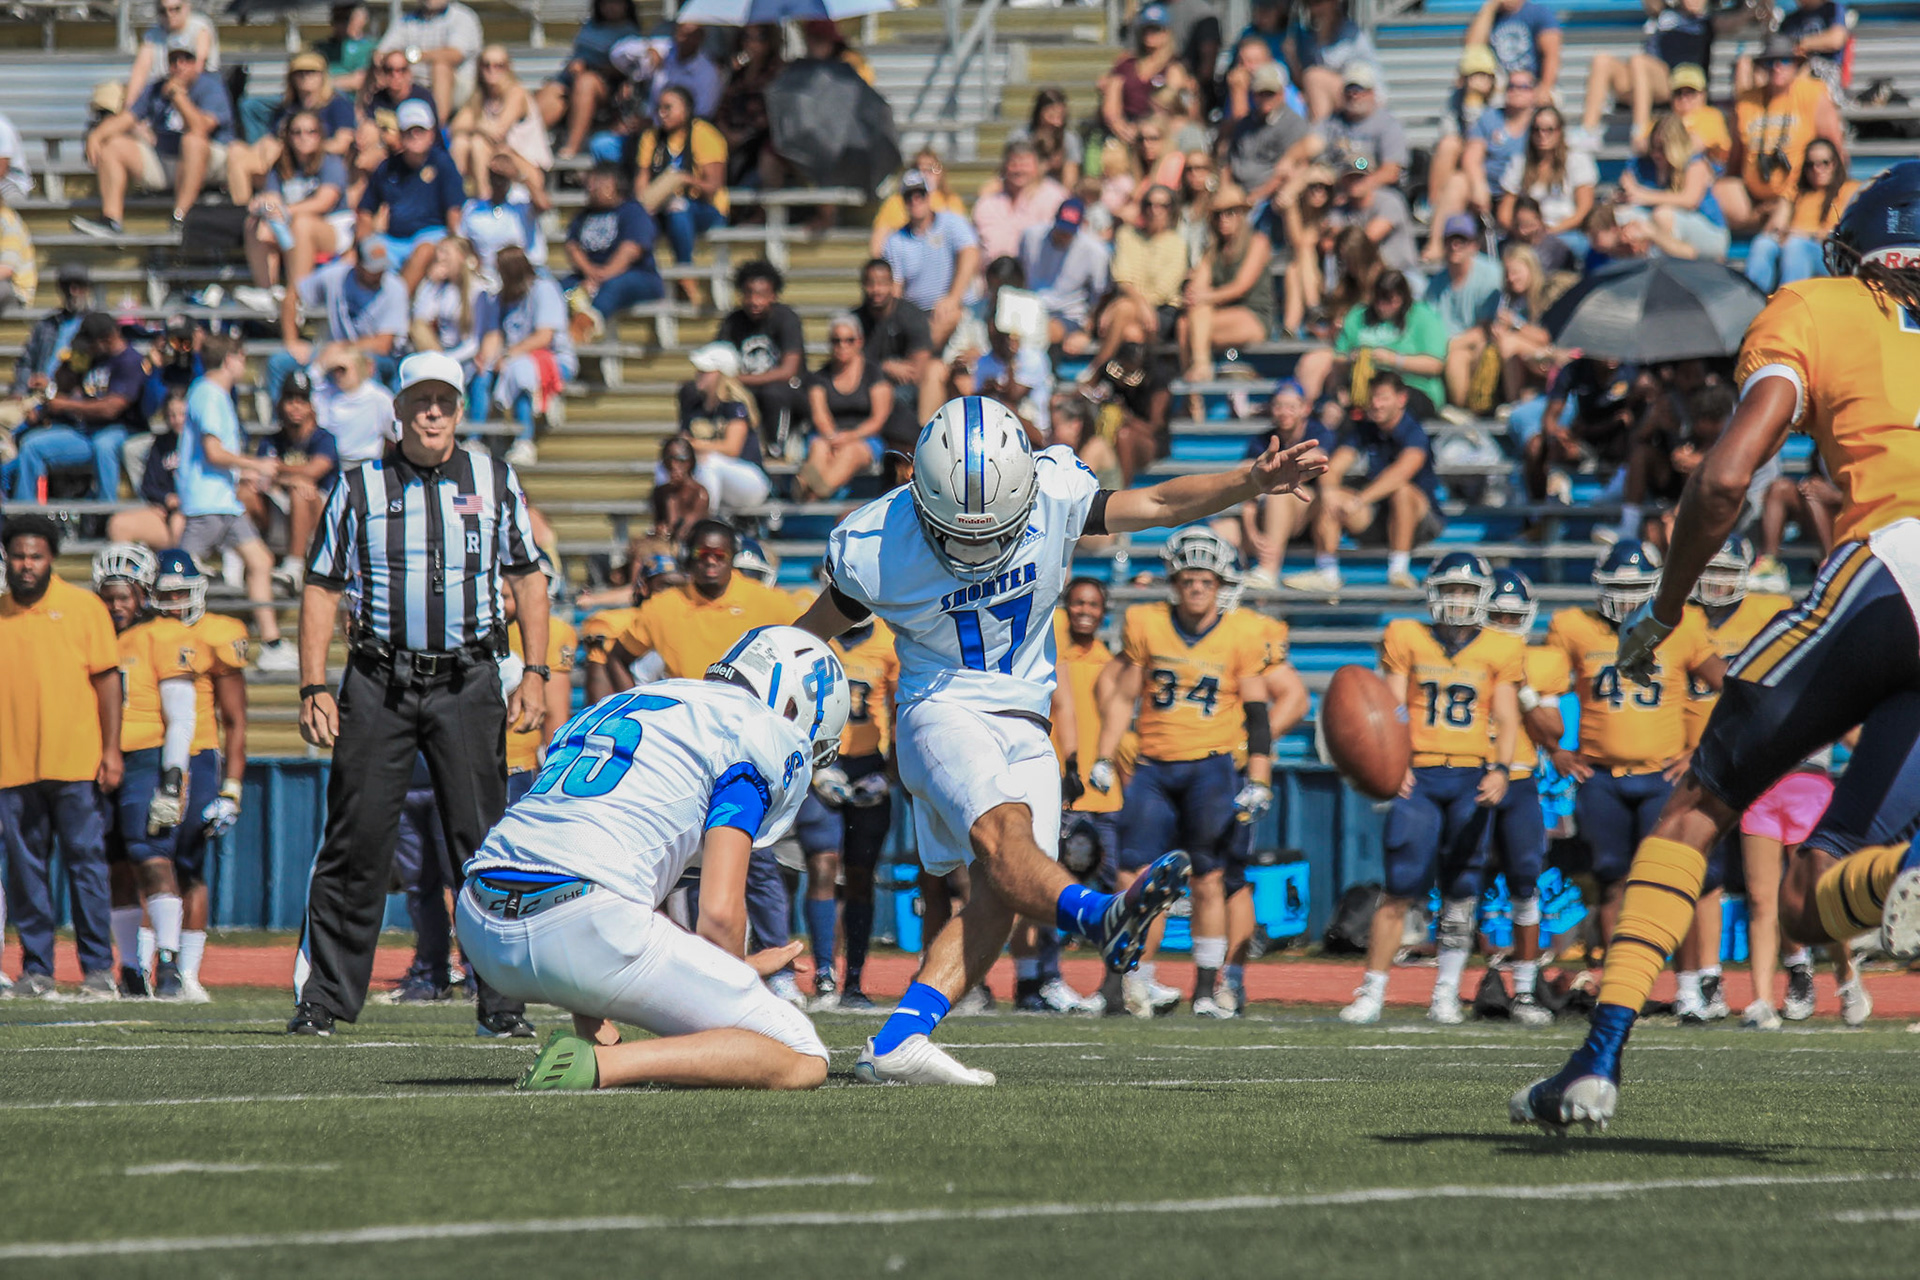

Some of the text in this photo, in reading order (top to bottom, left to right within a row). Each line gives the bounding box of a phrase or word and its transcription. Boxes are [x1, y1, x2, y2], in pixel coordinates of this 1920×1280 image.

[390, 499, 403, 512] S
[466, 532, 480, 554] R
[939, 562, 1037, 613] SHORTER
[946, 592, 1034, 675] 17
[1152, 669, 1220, 716] 34
[1419, 681, 1477, 728] 18
